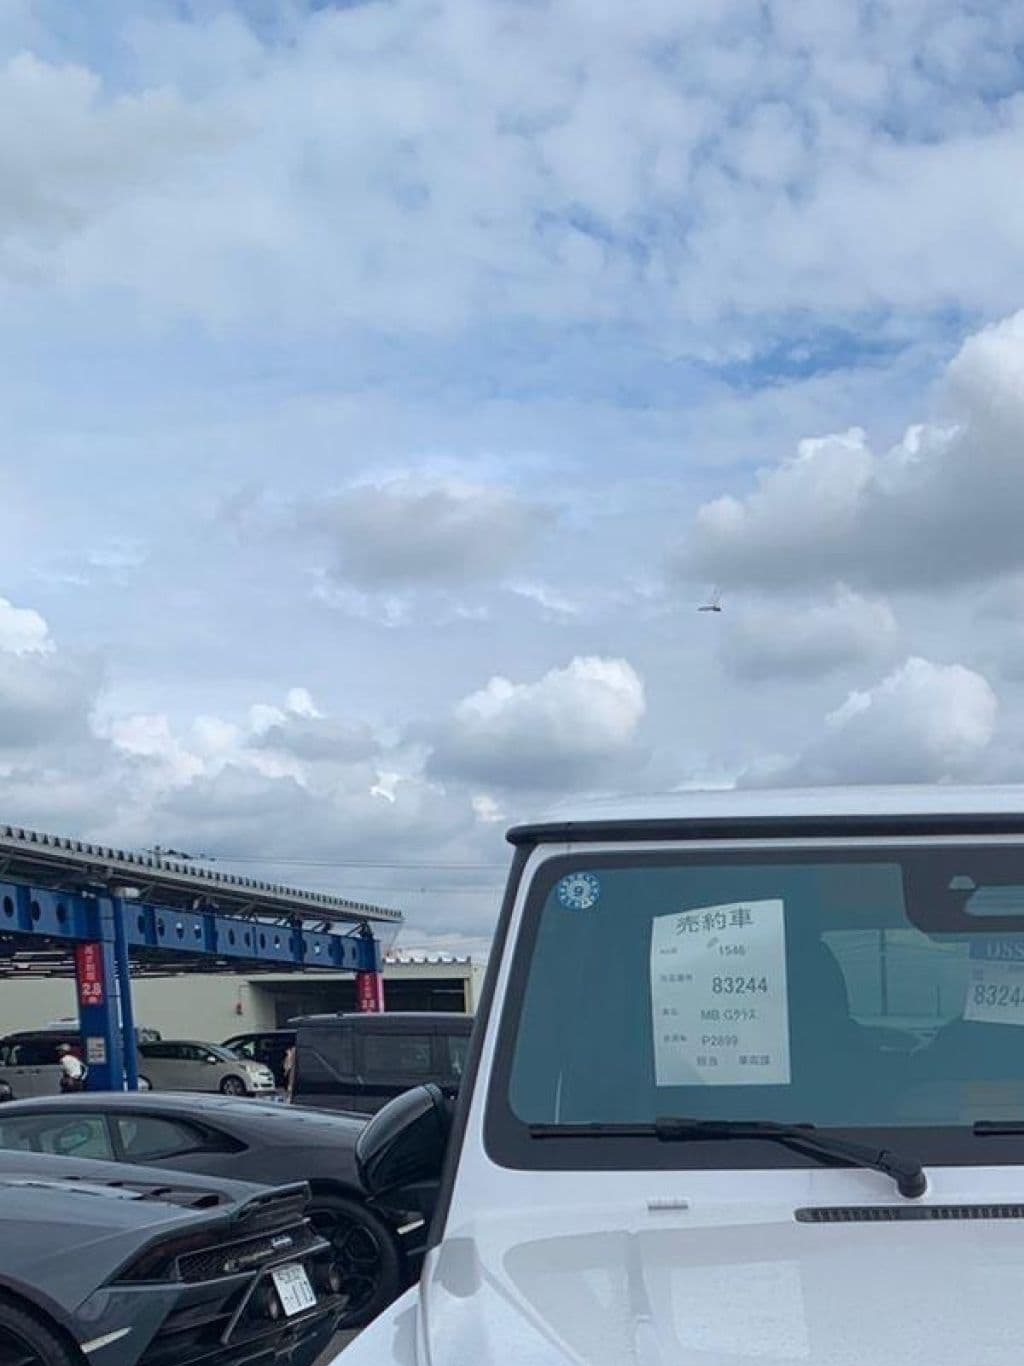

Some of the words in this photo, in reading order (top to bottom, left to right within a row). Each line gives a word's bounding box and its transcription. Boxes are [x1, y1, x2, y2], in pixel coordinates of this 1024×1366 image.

[675, 906, 755, 937] 売約車
[711, 976, 769, 995] 83244
